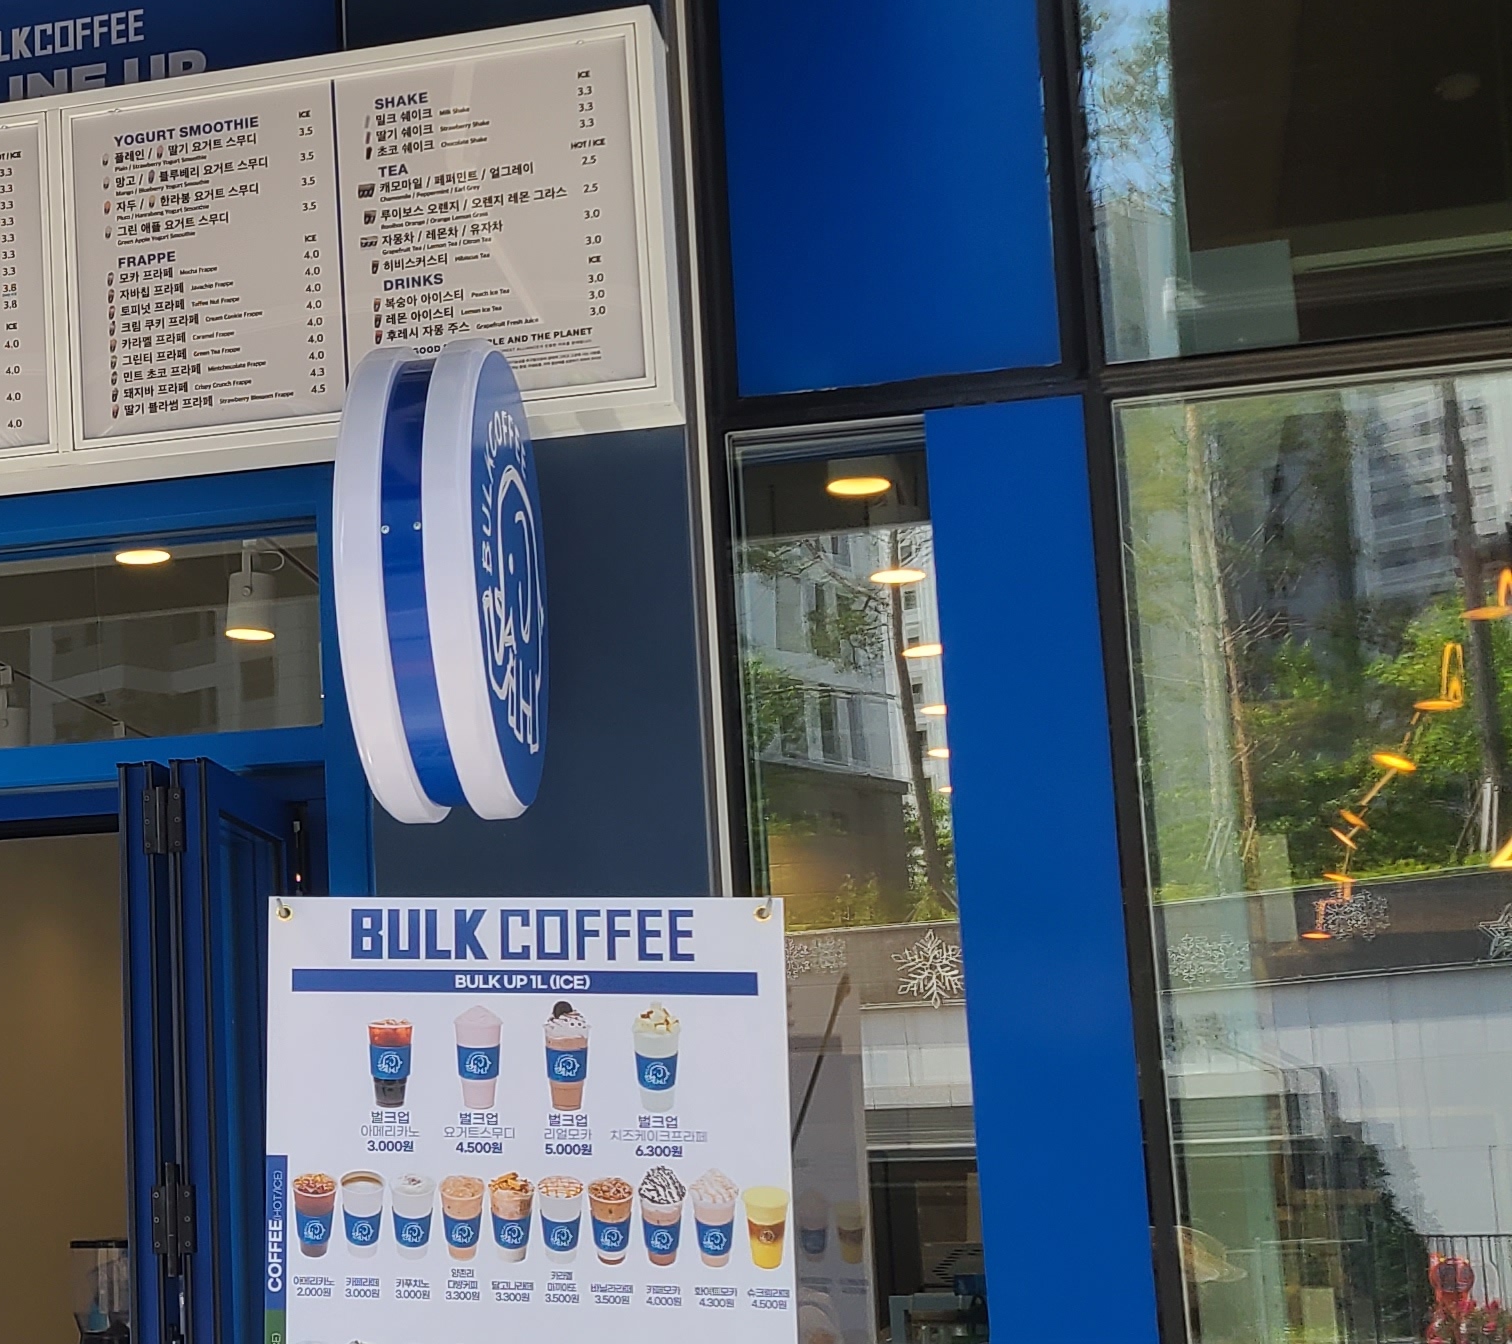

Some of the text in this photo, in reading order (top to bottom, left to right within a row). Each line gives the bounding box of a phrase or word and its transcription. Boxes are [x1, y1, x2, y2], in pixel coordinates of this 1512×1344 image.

[374, 92, 428, 110] SHAKE
[376, 108, 432, 126] 밀크 쉐이크
[114, 116, 259, 147] YOGURT SMOOTHIE
[401, 124, 434, 138] 쉐이크
[377, 140, 434, 158] 초코 쉐이크
[238, 156, 268, 171] 스무디
[378, 164, 408, 178] TEA
[117, 223, 137, 237] 그린
[198, 211, 229, 226] 스무디
[118, 251, 176, 268] FRAPPE
[120, 268, 173, 284] 모카 프라페
[383, 273, 444, 291] DRINKS
[420, 289, 464, 305] 아이스티
[145, 317, 165, 330] 쿠키
[168, 313, 199, 327] 프라페
[386, 307, 454, 326] 레몬 아이스티
[507, 334, 528, 344] AND
[531, 331, 551, 341] THE
[554, 327, 593, 338] PLANET
[350, 908, 695, 962] BULK COFFEE
[455, 974, 591, 991] BULK UP 1L (ICE)
[371, 1110, 410, 1124] 벌크업
[459, 1112, 499, 1126] 벌크업
[549, 1113, 588, 1127] 벌크업
[638, 1115, 678, 1129] 벌크업
[361, 1125, 420, 1138] 아메리카노
[443, 1126, 515, 1140] 요거트스무디
[544, 1128, 592, 1141] 리얼모카
[367, 1140, 414, 1153] 3.000원
[456, 1141, 503, 1154] 4.500원
[545, 1143, 592, 1156] 5.000원
[635, 1144, 683, 1158] 6.300원
[297, 1287, 331, 1297] 2.000원
[345, 1288, 380, 1299] 3.000원
